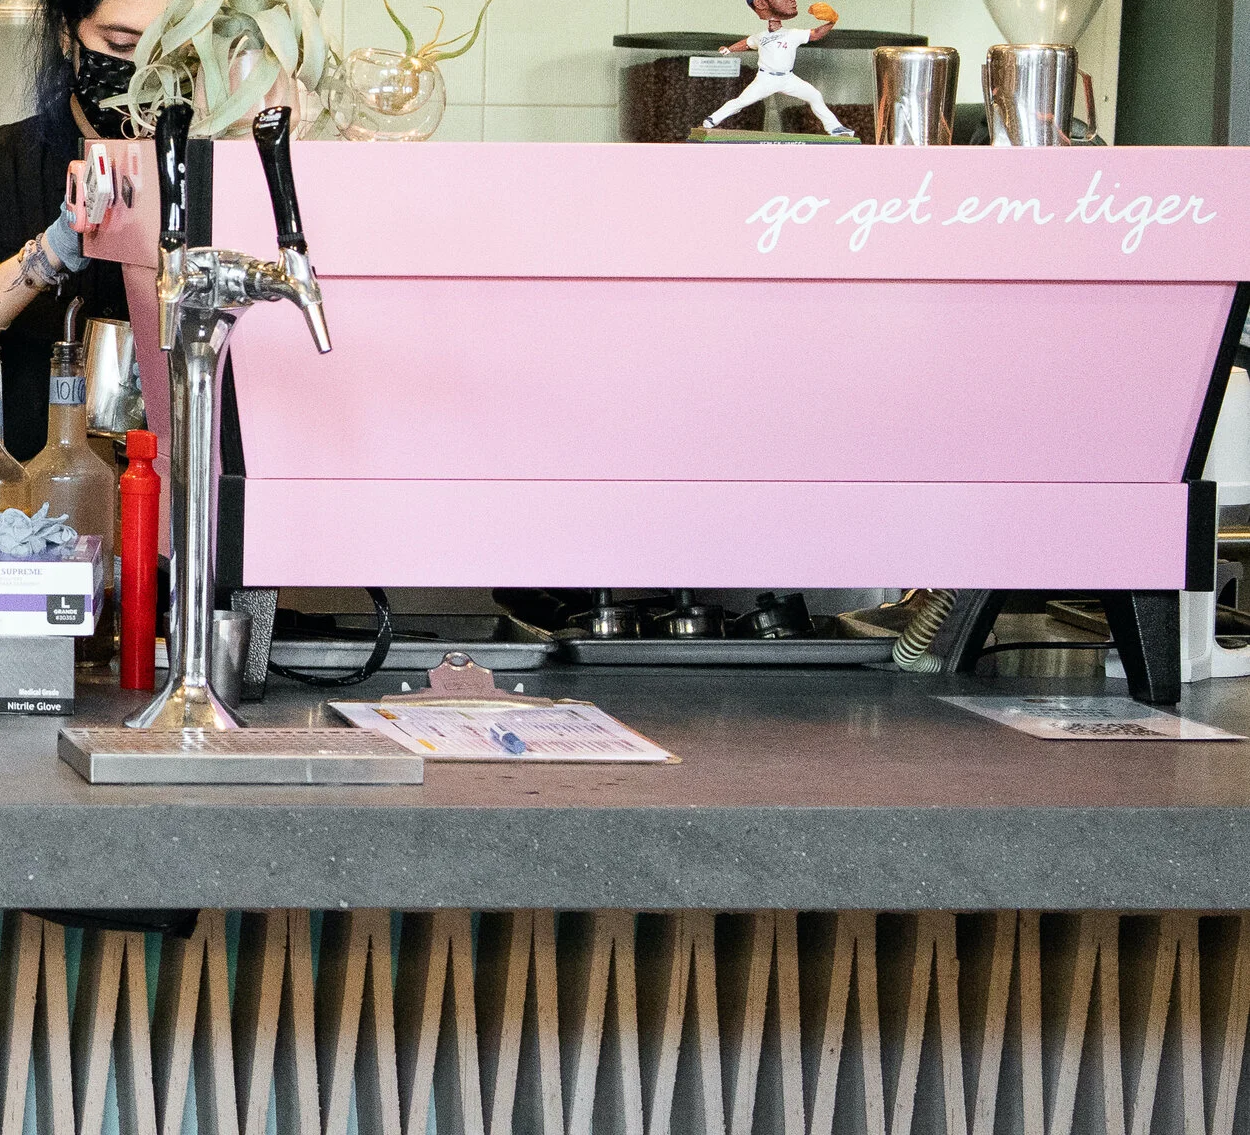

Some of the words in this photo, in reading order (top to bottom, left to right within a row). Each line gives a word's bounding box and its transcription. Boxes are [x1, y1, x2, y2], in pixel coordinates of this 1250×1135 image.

[776, 41, 788, 50] 74
[745, 193, 830, 255] go
[836, 169, 933, 253] get
[942, 193, 1056, 227] em
[1065, 169, 1217, 255] tiger
[1, 568, 44, 576] SUPREME
[60, 596, 70, 608] L
[7, 701, 35, 711] Nitrile
[36, 701, 62, 711] Glove
